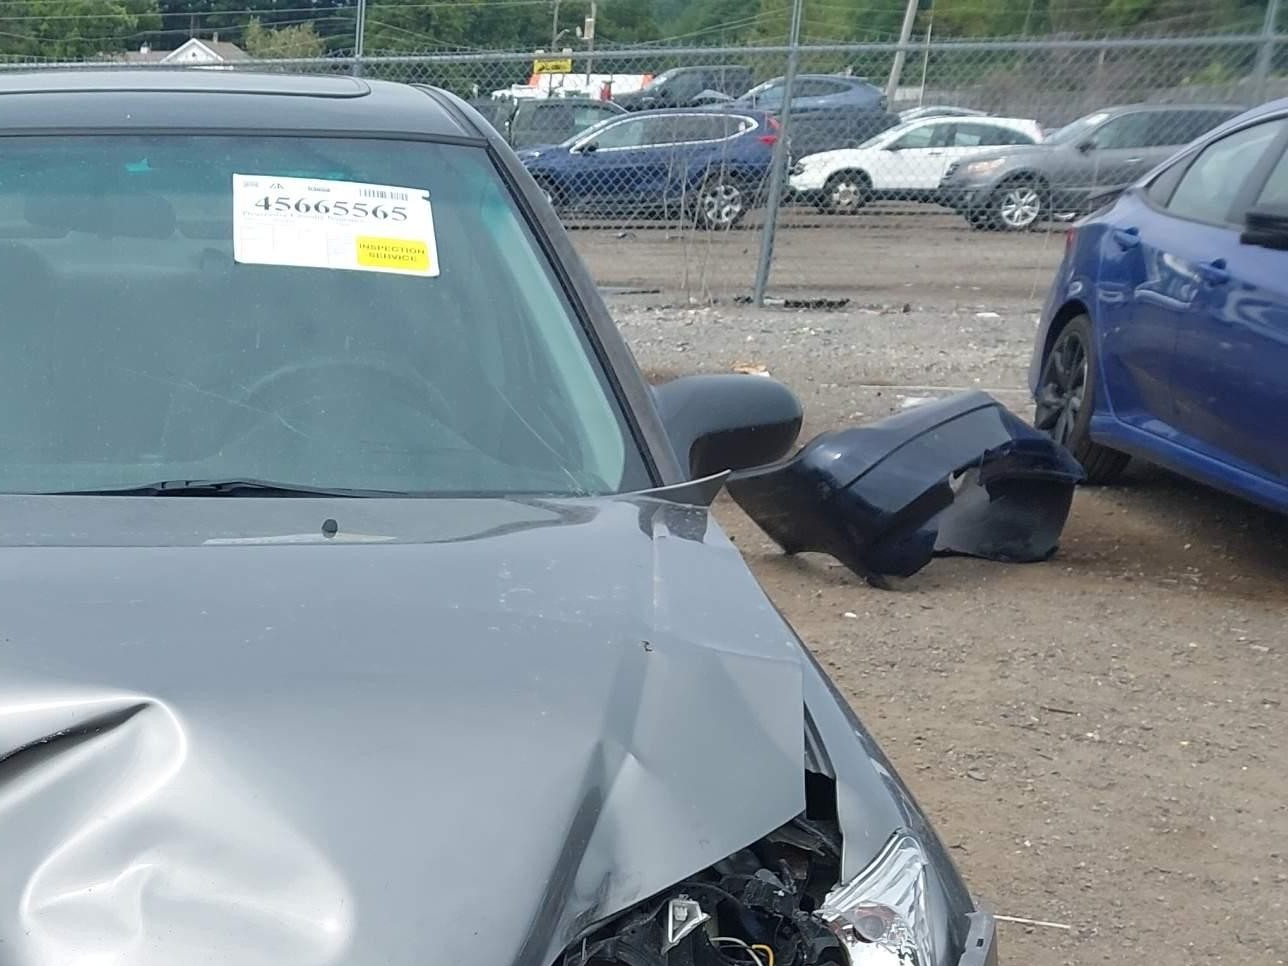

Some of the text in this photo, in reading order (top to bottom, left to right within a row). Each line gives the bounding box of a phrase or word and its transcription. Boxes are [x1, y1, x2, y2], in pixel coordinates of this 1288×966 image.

[254, 196, 408, 222] 45665565
[358, 244, 426, 255] INSPECTION
[369, 252, 417, 262] SERVICE
